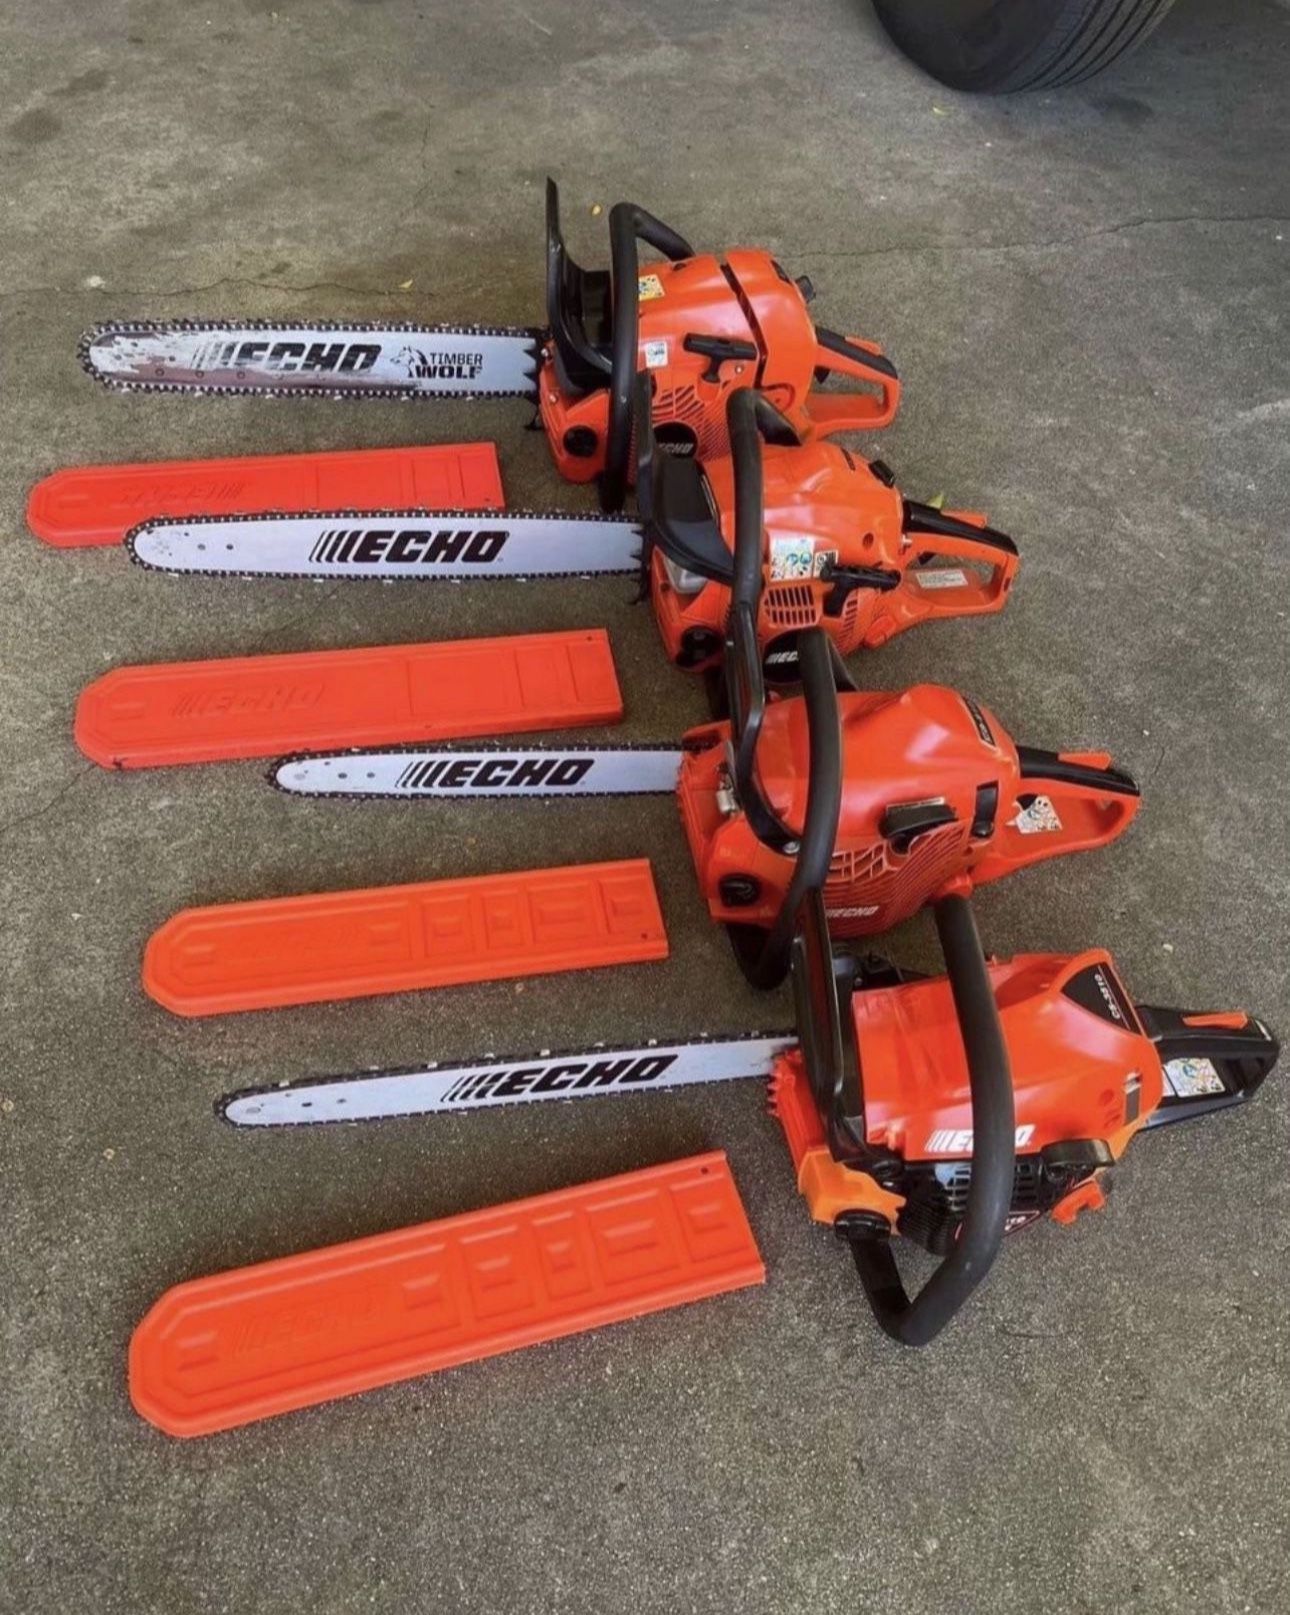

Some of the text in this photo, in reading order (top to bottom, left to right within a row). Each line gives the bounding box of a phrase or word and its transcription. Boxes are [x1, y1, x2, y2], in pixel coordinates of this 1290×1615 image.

[234, 342, 382, 374] ECHO
[415, 364, 484, 379] WOLF
[429, 352, 484, 366] TIMBER
[353, 530, 510, 564] ECHO
[438, 758, 596, 788] ECHO
[492, 1054, 679, 1098] ECHO
[943, 1124, 1036, 1152] EO
